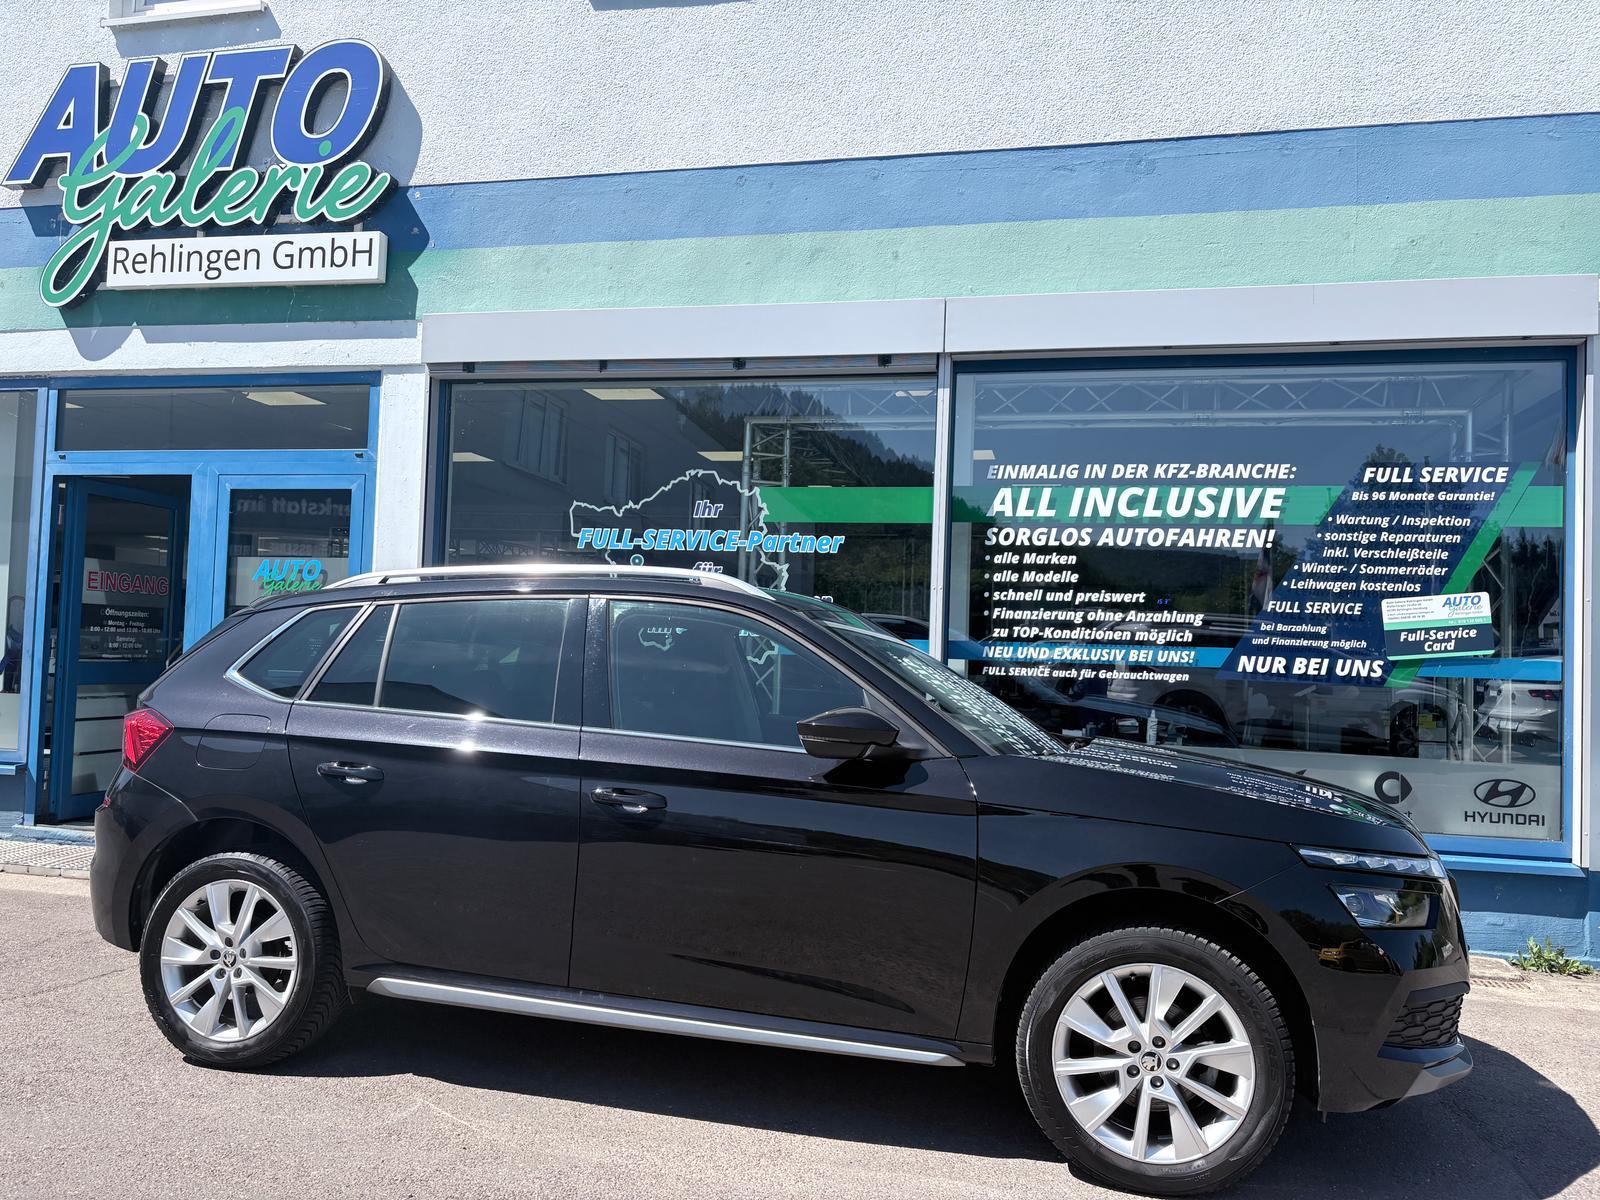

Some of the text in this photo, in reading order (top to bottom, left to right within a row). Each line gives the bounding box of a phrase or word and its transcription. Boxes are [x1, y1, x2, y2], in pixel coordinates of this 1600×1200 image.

[2, 38, 385, 185] AUTO
[40, 105, 391, 308] Galerie
[112, 238, 373, 281] Rehlingen GmbH
[987, 463, 1297, 479] EINMALIG IN DER KFZ-BRANCHE:
[1363, 466, 1509, 483] FULL SERVICE
[986, 487, 1286, 519] ALL INCLUSIVE
[1352, 491, 1495, 501] Bis 96 Monate Garantie!
[693, 500, 724, 518] Ihr
[1336, 514, 1471, 528] Wartung / Inspektion
[577, 528, 845, 553] FULL-SERVICE-Partner
[985, 527, 1276, 549] SORGLOS AUTOFAHREN!
[1325, 531, 1461, 545] sonstige Reparaturen
[993, 552, 1076, 565] alle Marken
[1323, 547, 1449, 560] inkl. Verschleißteile
[252, 559, 321, 582] AUTO
[993, 570, 1079, 583] alle Modelle
[1301, 562, 1347, 574] Winter-
[1359, 563, 1448, 576] Sommerräder
[87, 571, 168, 594] EINGANG
[260, 571, 321, 596] Galerie
[1290, 579, 1421, 592] Leihwagen kostenlos
[993, 589, 1042, 601] schnell
[1045, 591, 1072, 602] und
[1074, 591, 1146, 605] preiswert
[1442, 595, 1481, 607] AUTO
[1267, 600, 1363, 615] FULL SERVICE
[993, 608, 1204, 627] Finanzierung ohne Anzahlung
[993, 627, 1193, 644] zu TOP-Konditionen möglich
[1261, 623, 1327, 634] bei Barzahlung
[1400, 628, 1477, 642] Full-Service
[1252, 637, 1367, 649] und Finanzierung möglich
[1424, 640, 1455, 651] Card
[982, 646, 1195, 663] NEU UND EXKLUSIV BEI UNS!
[1237, 655, 1384, 677] NUR BEI UNS
[982, 667, 1189, 682] FULL SERVICE auch für Gebrauchtwagen
[1465, 811, 1545, 826] HYUNDAI
